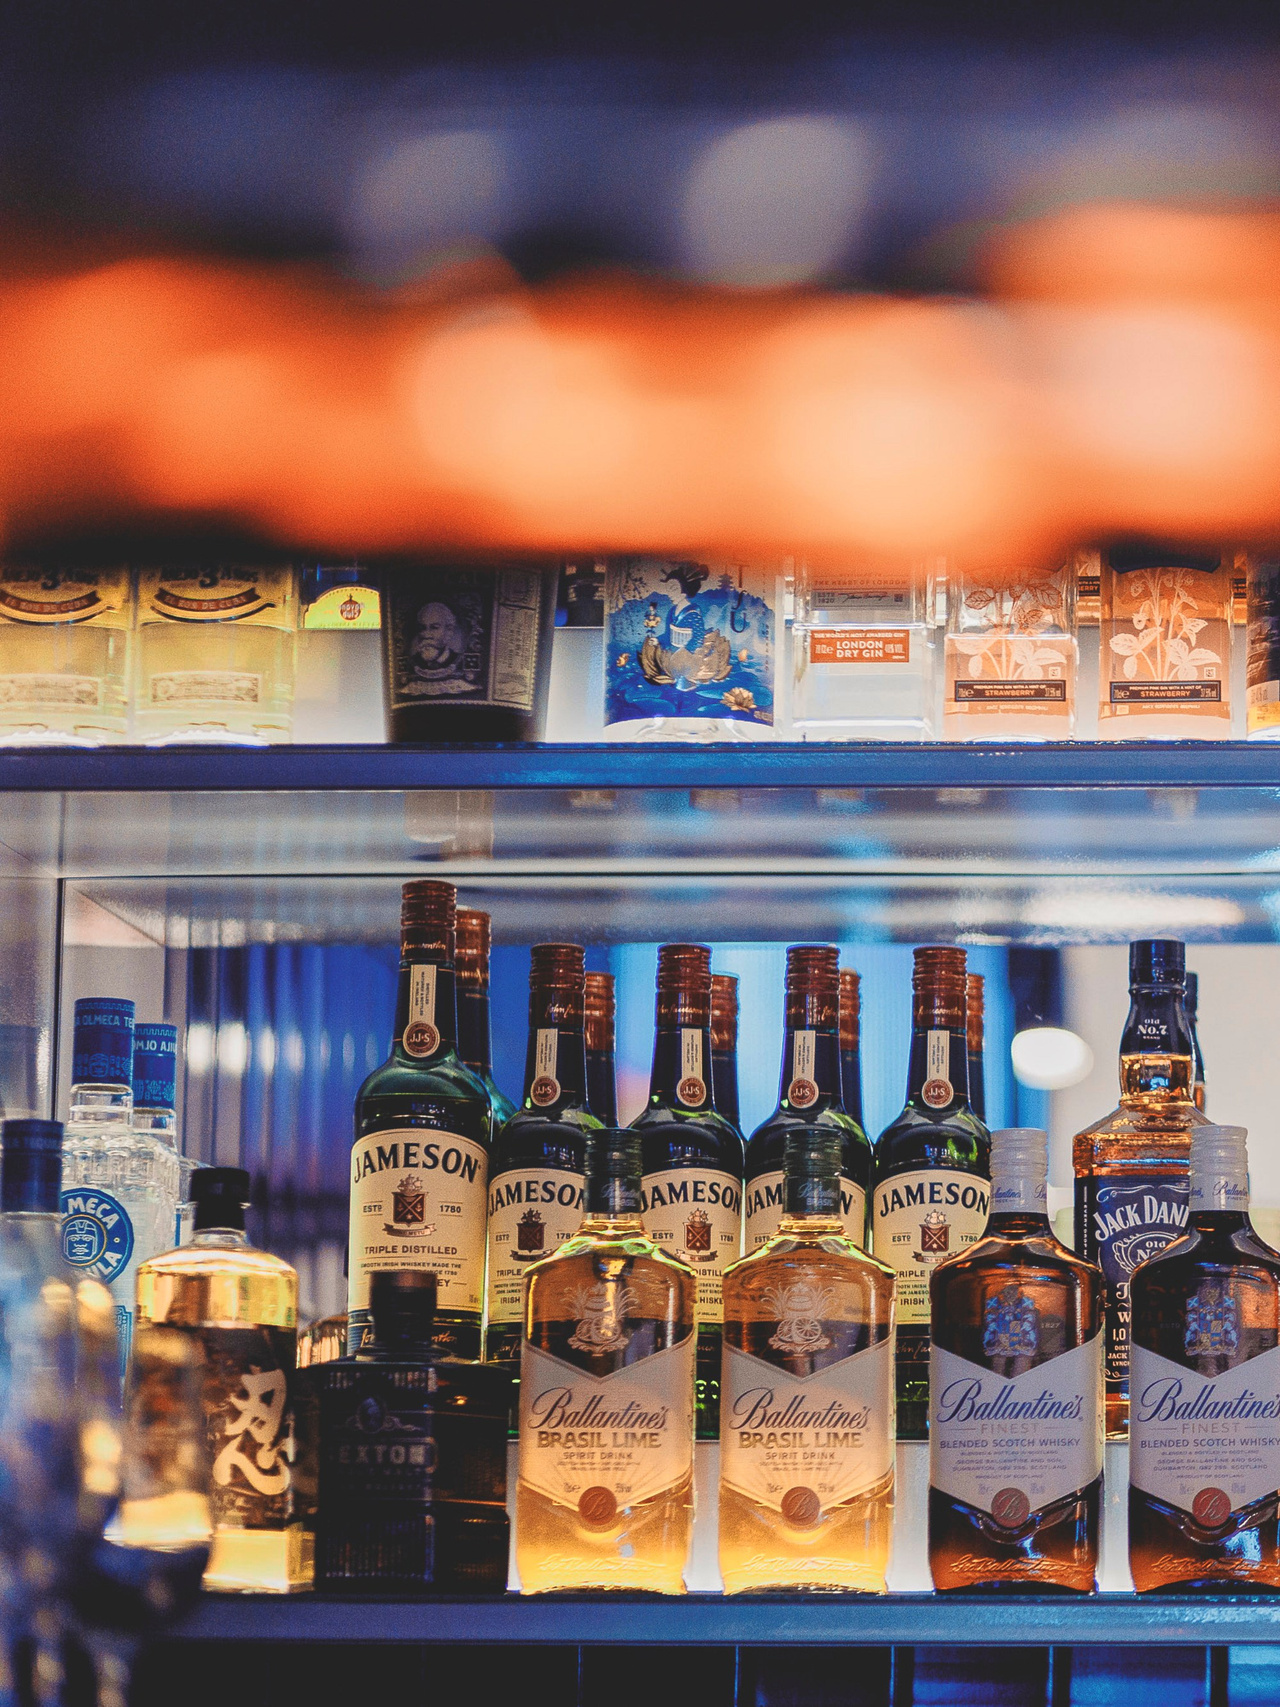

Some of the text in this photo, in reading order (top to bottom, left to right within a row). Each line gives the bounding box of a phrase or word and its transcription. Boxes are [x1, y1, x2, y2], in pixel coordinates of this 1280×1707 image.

[836, 640, 883, 649] LONDON
[836, 649, 860, 658] DRY
[862, 649, 884, 658] GIN
[82, 1014, 121, 1026] OLMECA
[1136, 1024, 1168, 1036] No.7
[353, 1142, 481, 1184] JAMESON
[641, 1180, 740, 1216] JAMESON
[746, 1182, 853, 1218] JAMN
[879, 1182, 990, 1217] JAMESON
[440, 1203, 462, 1214] 1780
[1092, 1195, 1190, 1242] JACK DANI
[720, 1234, 734, 1243] 1780
[1145, 1240, 1166, 1248] Old
[364, 1245, 458, 1259] TRIPLE DISTILLED
[361, 1262, 381, 1270] SMOOTH
[400, 1261, 431, 1269] WHISKEY
[432, 1262, 450, 1270] MADE
[496, 1268, 522, 1277] TRIPLE
[500, 1296, 521, 1304] IRISH
[900, 1297, 925, 1306] IRISH
[1107, 1352, 1128, 1361] JACK
[936, 1377, 1084, 1423] Ballantine's
[528, 1386, 669, 1430] Ballantine's
[728, 1387, 872, 1430] Ballantine's
[981, 1422, 1040, 1435] FINEST
[1181, 1422, 1241, 1434] FINEST
[537, 1431, 662, 1449] BRASIL LIME
[739, 1431, 864, 1450] BRASIL LIME
[940, 1438, 1081, 1449] BLENDED SCOTCH WHISKY
[1140, 1440, 1190, 1449] BLENDED
[1193, 1438, 1236, 1448] SCOTCH
[329, 1443, 427, 1466] EXTON
[563, 1451, 633, 1460] SPIRIT DRINK
[765, 1452, 835, 1460] SPIRIT DRINK
